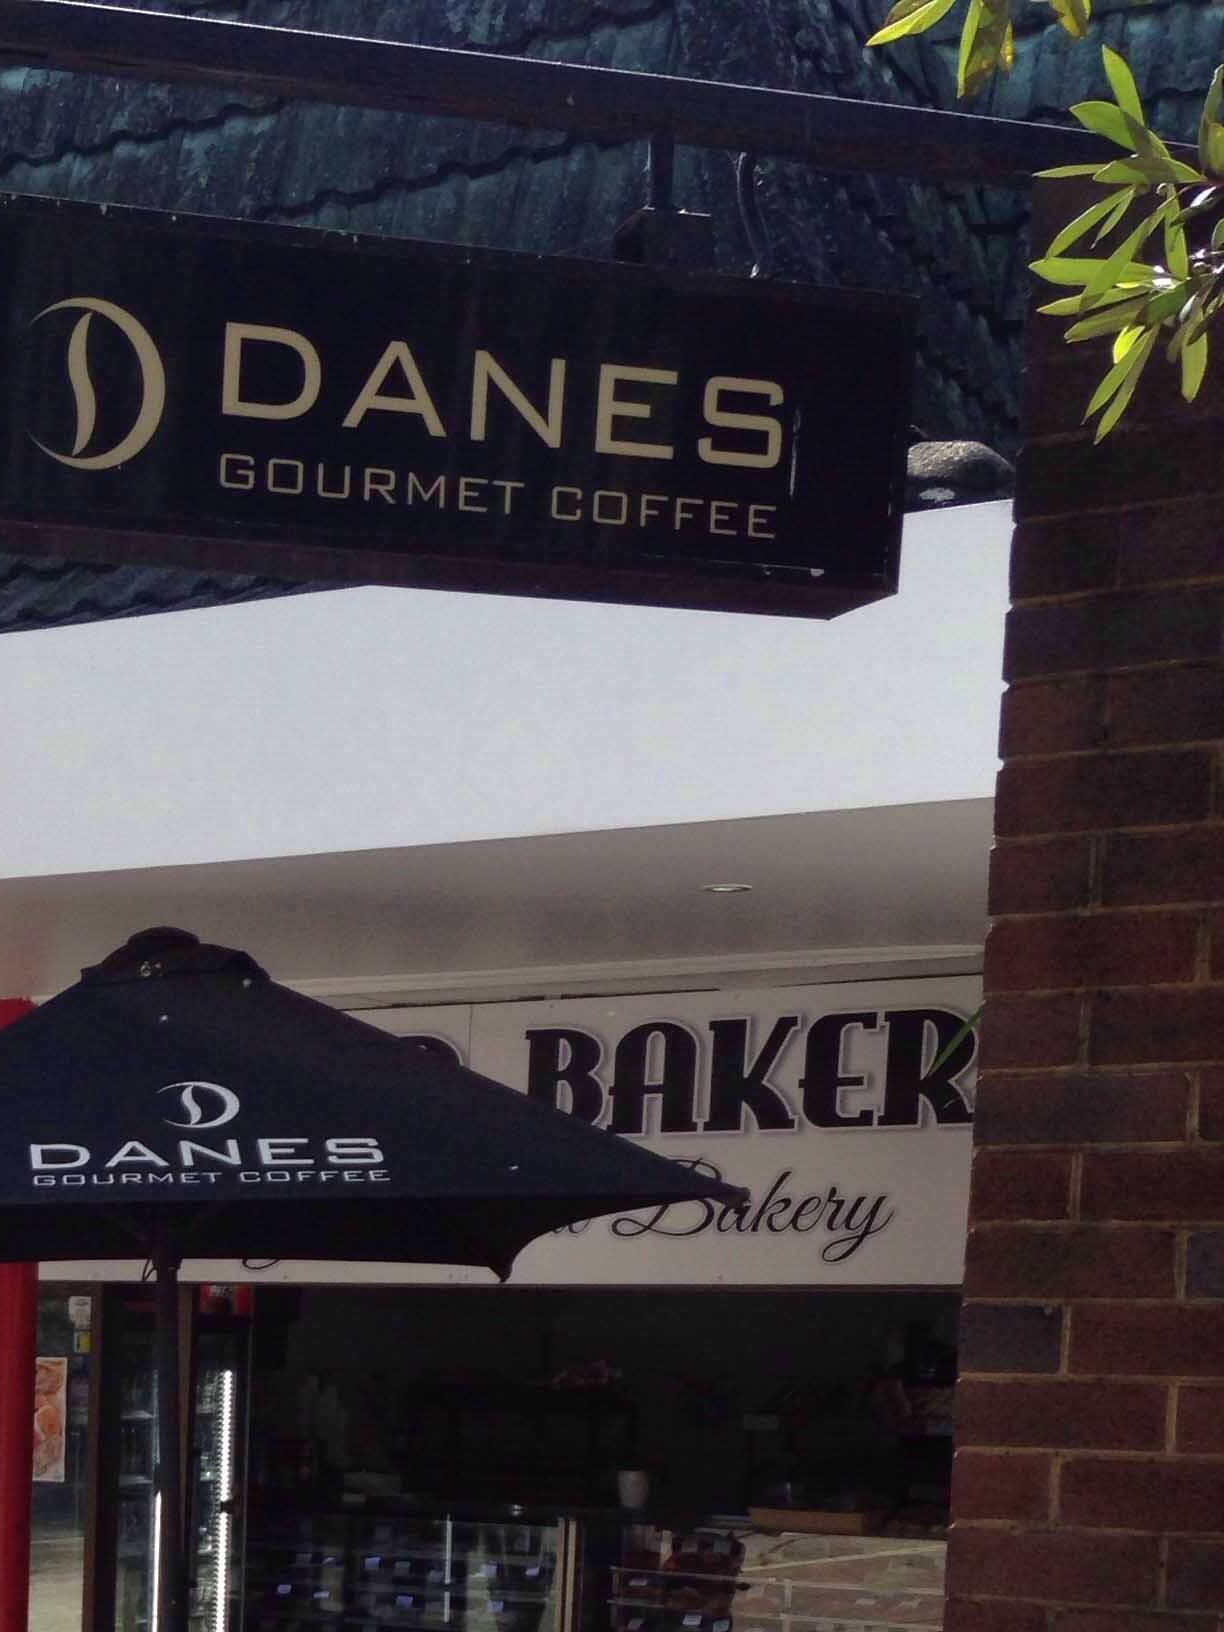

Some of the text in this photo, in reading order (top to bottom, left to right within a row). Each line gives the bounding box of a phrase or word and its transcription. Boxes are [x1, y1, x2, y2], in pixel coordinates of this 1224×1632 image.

[221, 321, 785, 470] DANES
[219, 453, 778, 540] GOURMET COFFEE
[524, 1008, 976, 1133] BAKER
[29, 1137, 386, 1170] DANES
[32, 1169, 391, 1187] GOURMET COFFEE
[612, 1156, 895, 1263] Bakery
